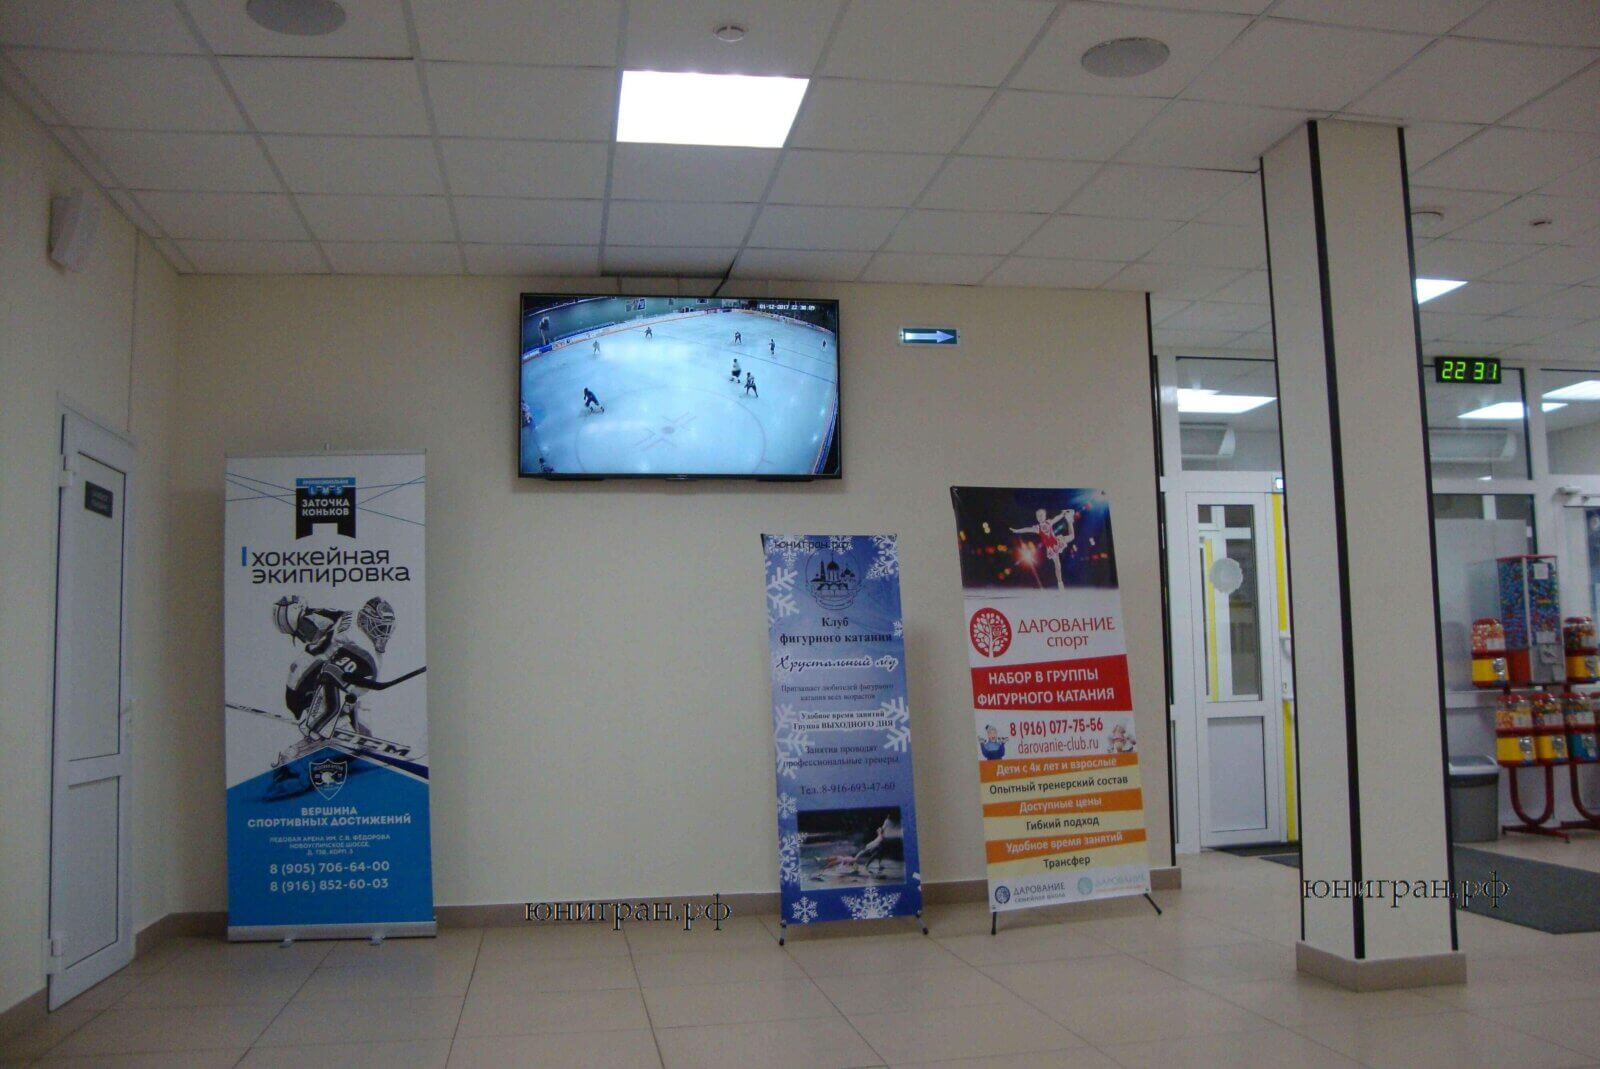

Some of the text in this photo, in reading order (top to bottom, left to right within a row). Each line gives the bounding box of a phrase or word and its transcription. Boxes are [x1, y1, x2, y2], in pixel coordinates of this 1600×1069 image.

[1442, 361, 1497, 380] 22 31
[302, 498, 350, 508] ЗАТОЧКА
[302, 508, 349, 516] КОНЬКОВ
[822, 617, 849, 629] Клуб
[1017, 616, 1115, 634] ДАРОВАНИЕ
[779, 633, 841, 646] фигурного
[845, 634, 892, 643] катания
[1047, 634, 1089, 650] спорт
[776, 655, 872, 672] Хрустальный
[988, 668, 1099, 685] НАБОР В ГРУППЫ
[977, 688, 1115, 706] ФИГУРНОГО КАТАНИЯ
[801, 710, 885, 720] Удобное время занятий
[793, 720, 893, 731] Группа ВЫХОДНОГО ДНЯ
[1010, 718, 1104, 738] 8 (916) 077-75-56
[804, 745, 878, 754] Занятия проводят
[1017, 737, 1099, 754] darovanie-club.ru
[782, 756, 899, 768] профессиональные тренеры
[996, 764, 1021, 776] Дети
[1022, 766, 1028, 774] с
[1043, 763, 1060, 772] лет
[1070, 758, 1117, 772] взрослые
[989, 777, 1128, 795] Опытный тренерский состав
[301, 806, 358, 816] ВЕРШИНА
[1019, 798, 1102, 815] Доступные цены
[247, 813, 412, 828] СПОРТИВНЫХ ДОСТИЖЕНИЙ
[1026, 816, 1099, 831] Гибкий подход
[1006, 832, 1123, 854] Удобное время занятий
[270, 861, 390, 876] 8 (905) 706-64-00
[1043, 854, 1091, 870] Трансфер
[270, 878, 389, 894] 8 (916) 852-60-03
[1013, 882, 1065, 895] ДАРОВАНИЕ
